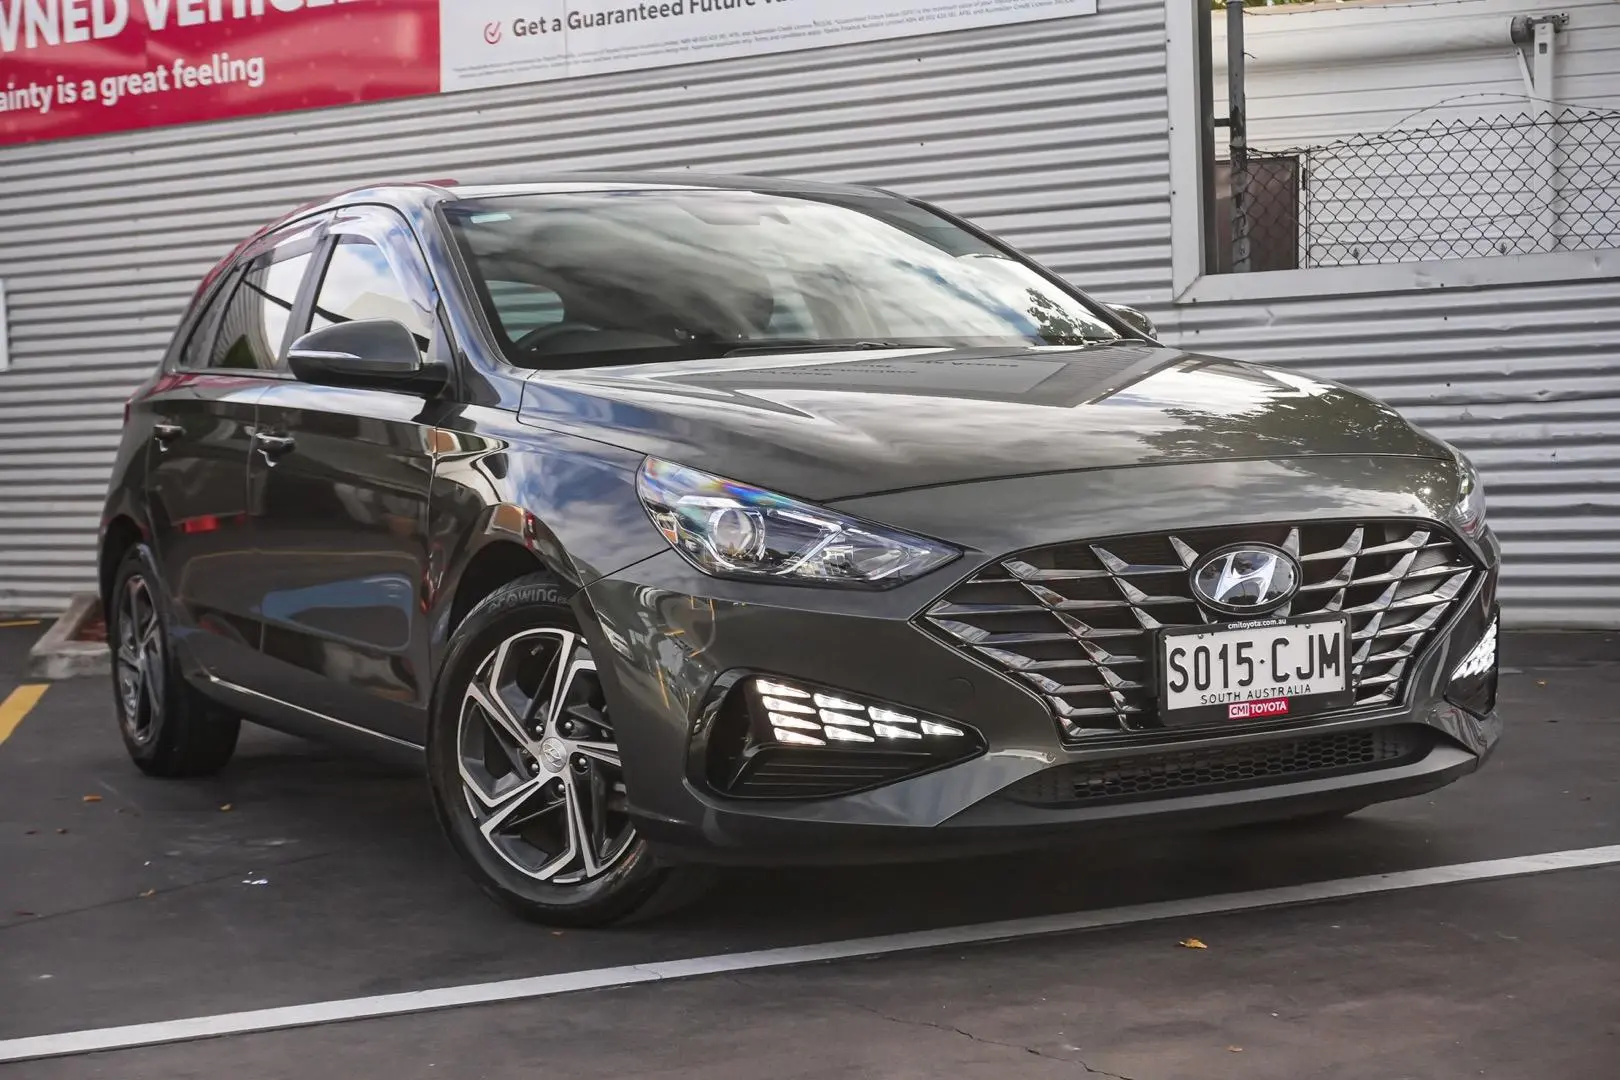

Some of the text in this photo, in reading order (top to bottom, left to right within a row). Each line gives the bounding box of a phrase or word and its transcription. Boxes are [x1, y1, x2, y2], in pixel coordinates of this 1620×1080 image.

[512, 16, 547, 37] Get
[551, 17, 562, 32] a
[567, 0, 683, 30] Guaranteed
[56, 75, 77, 105] is
[81, 79, 97, 102] a
[100, 64, 171, 106] great
[172, 52, 266, 88] feeling
[1227, 618, 1287, 630] cmitoyota.com.au
[1200, 683, 1312, 705] SOUTH AUSTRALIA
[1250, 700, 1288, 714] TOYOTA
